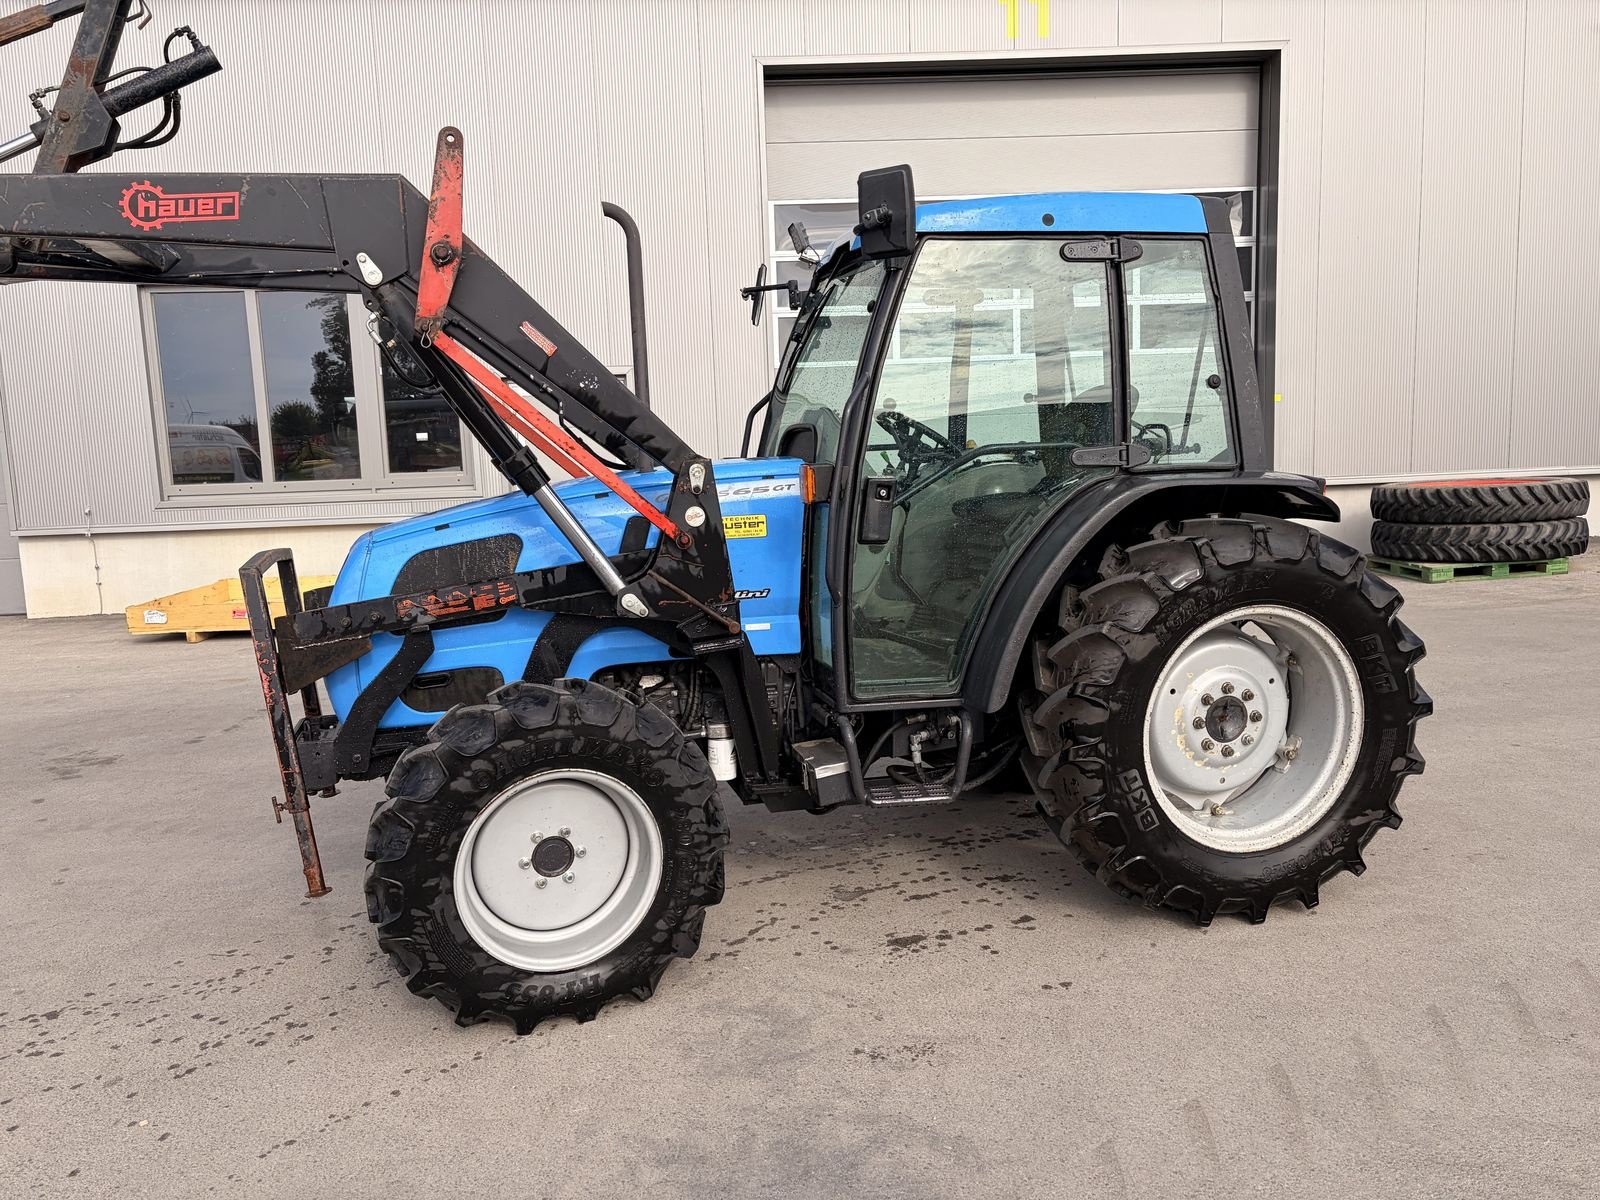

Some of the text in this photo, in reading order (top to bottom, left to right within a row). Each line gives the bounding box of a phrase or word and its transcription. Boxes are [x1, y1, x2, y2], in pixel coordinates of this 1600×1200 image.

[998, 0, 1049, 38] 11
[772, 483, 796, 492] GT
[1355, 633, 1399, 693] BKT
[1118, 768, 1160, 832] BKT
